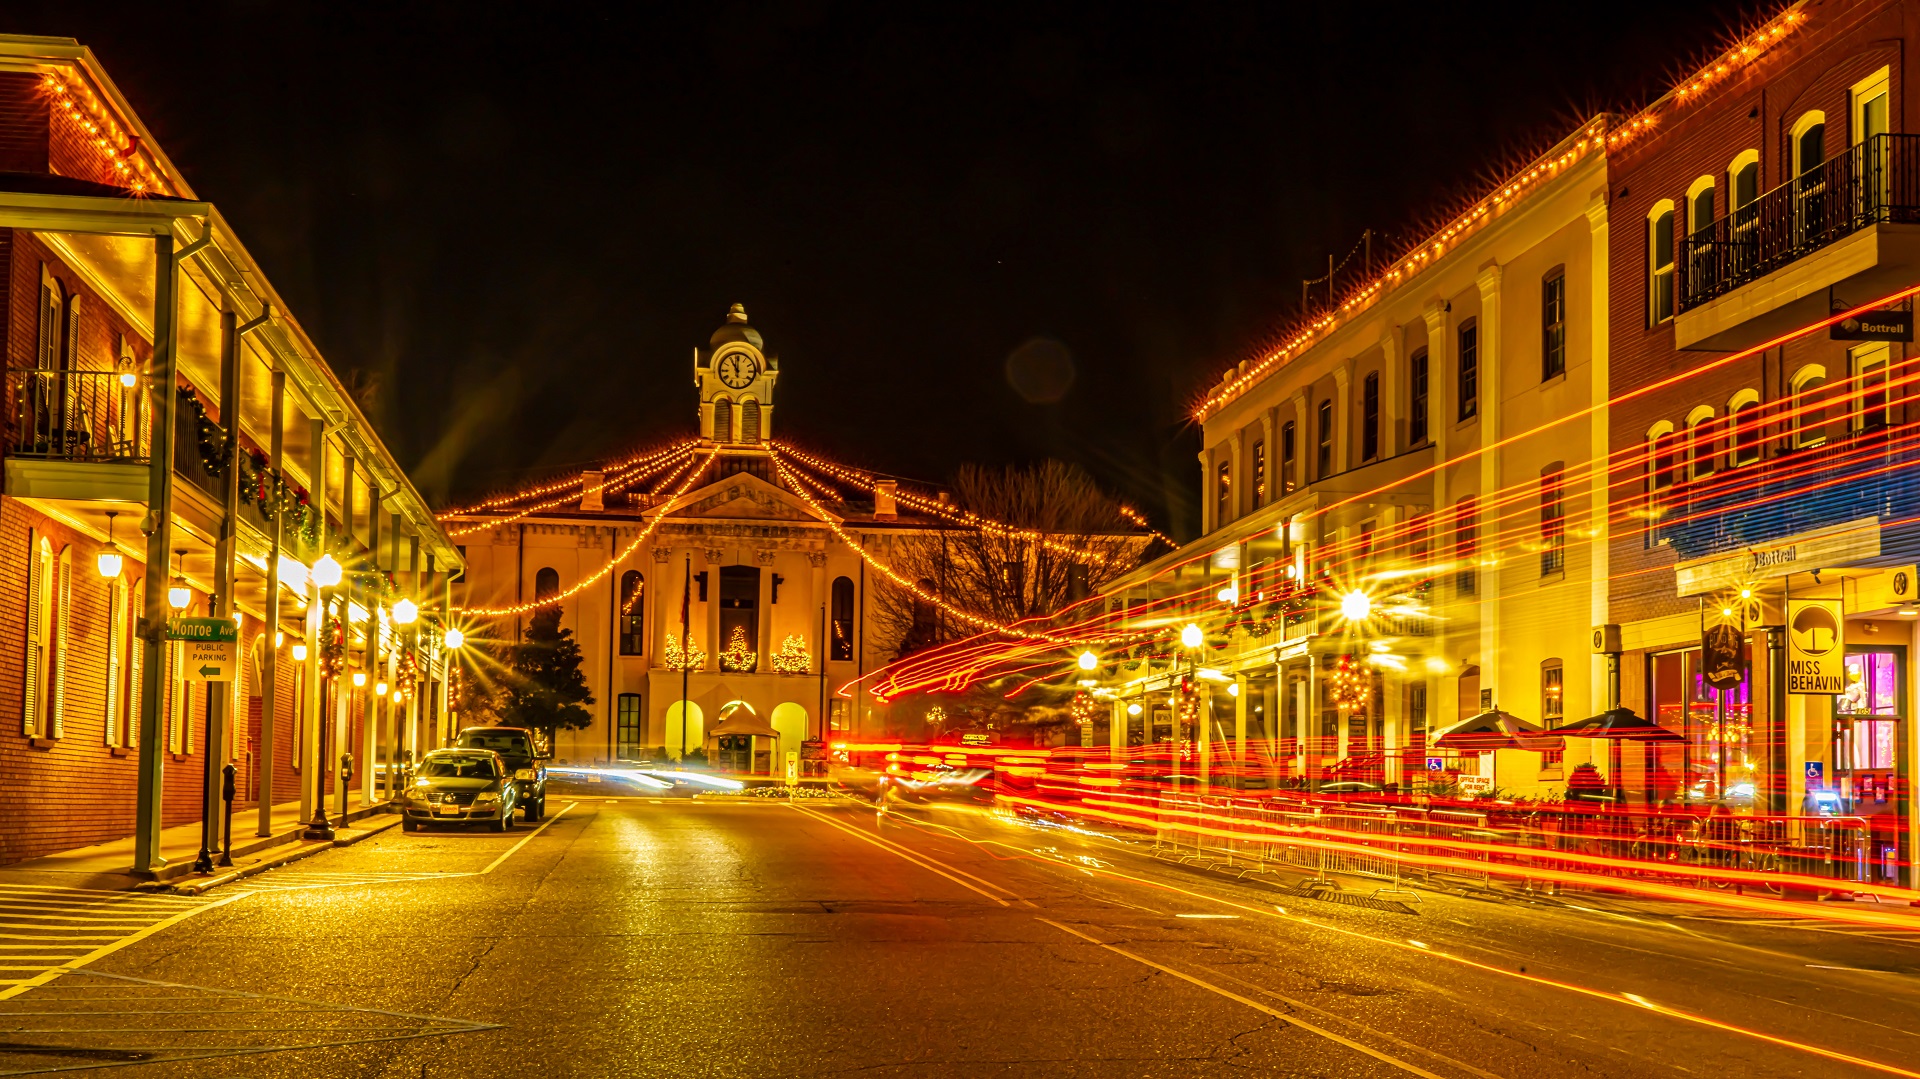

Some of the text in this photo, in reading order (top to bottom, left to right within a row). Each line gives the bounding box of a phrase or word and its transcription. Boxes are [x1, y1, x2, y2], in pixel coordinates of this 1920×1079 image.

[1861, 322, 1904, 333] Bottrell
[1758, 545, 1797, 566] Bottrell
[171, 620, 234, 637] Monroe Ave
[195, 643, 224, 651] PUBLIC
[192, 653, 227, 661] PARKING
[1790, 660, 1820, 675] MISS
[1791, 676, 1841, 690] BEHAVIN
